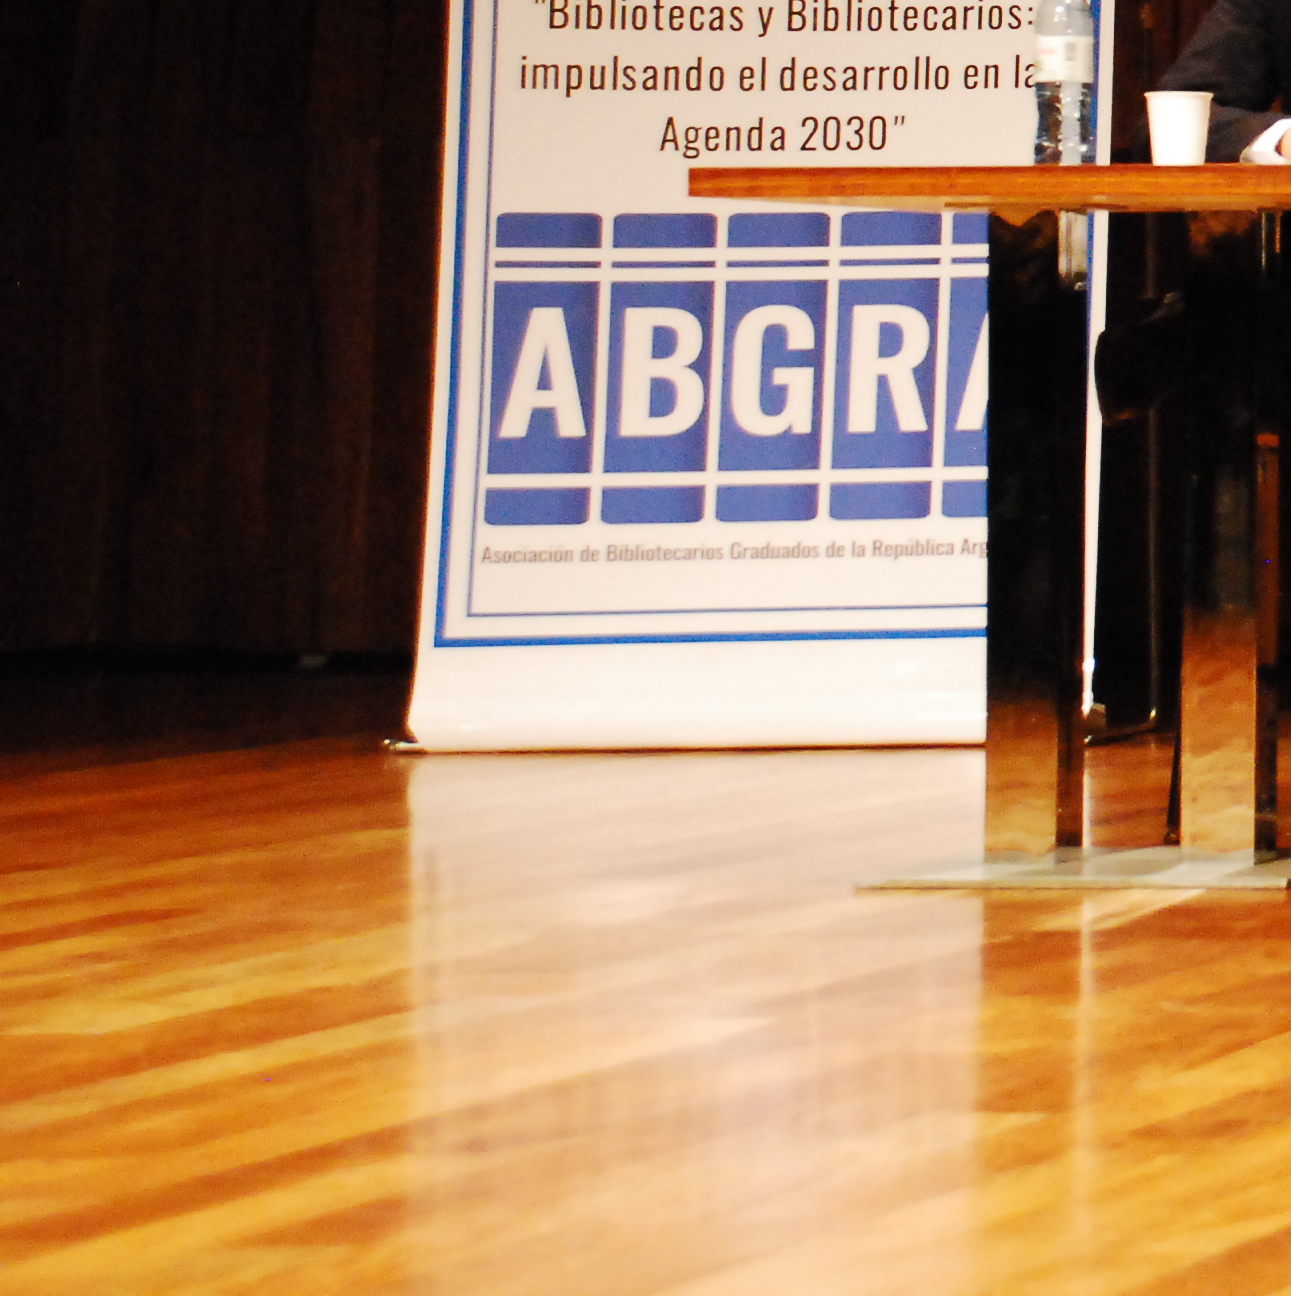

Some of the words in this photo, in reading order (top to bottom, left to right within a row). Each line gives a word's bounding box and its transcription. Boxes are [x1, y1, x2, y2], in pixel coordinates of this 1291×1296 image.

[757, 6, 775, 38] y
[520, 55, 726, 98] impulsando
[738, 56, 768, 92] el
[779, 55, 951, 92] desarrollo
[963, 63, 1000, 90] en
[659, 116, 787, 160] Agenda
[799, 115, 907, 152] 2030"
[481, 544, 575, 564] Asociación
[580, 545, 600, 563] de
[606, 543, 725, 563] Bibliotecarios
[729, 541, 820, 560] Graduados
[825, 540, 846, 559] de
[851, 540, 867, 558] la
[872, 537, 955, 561] República
